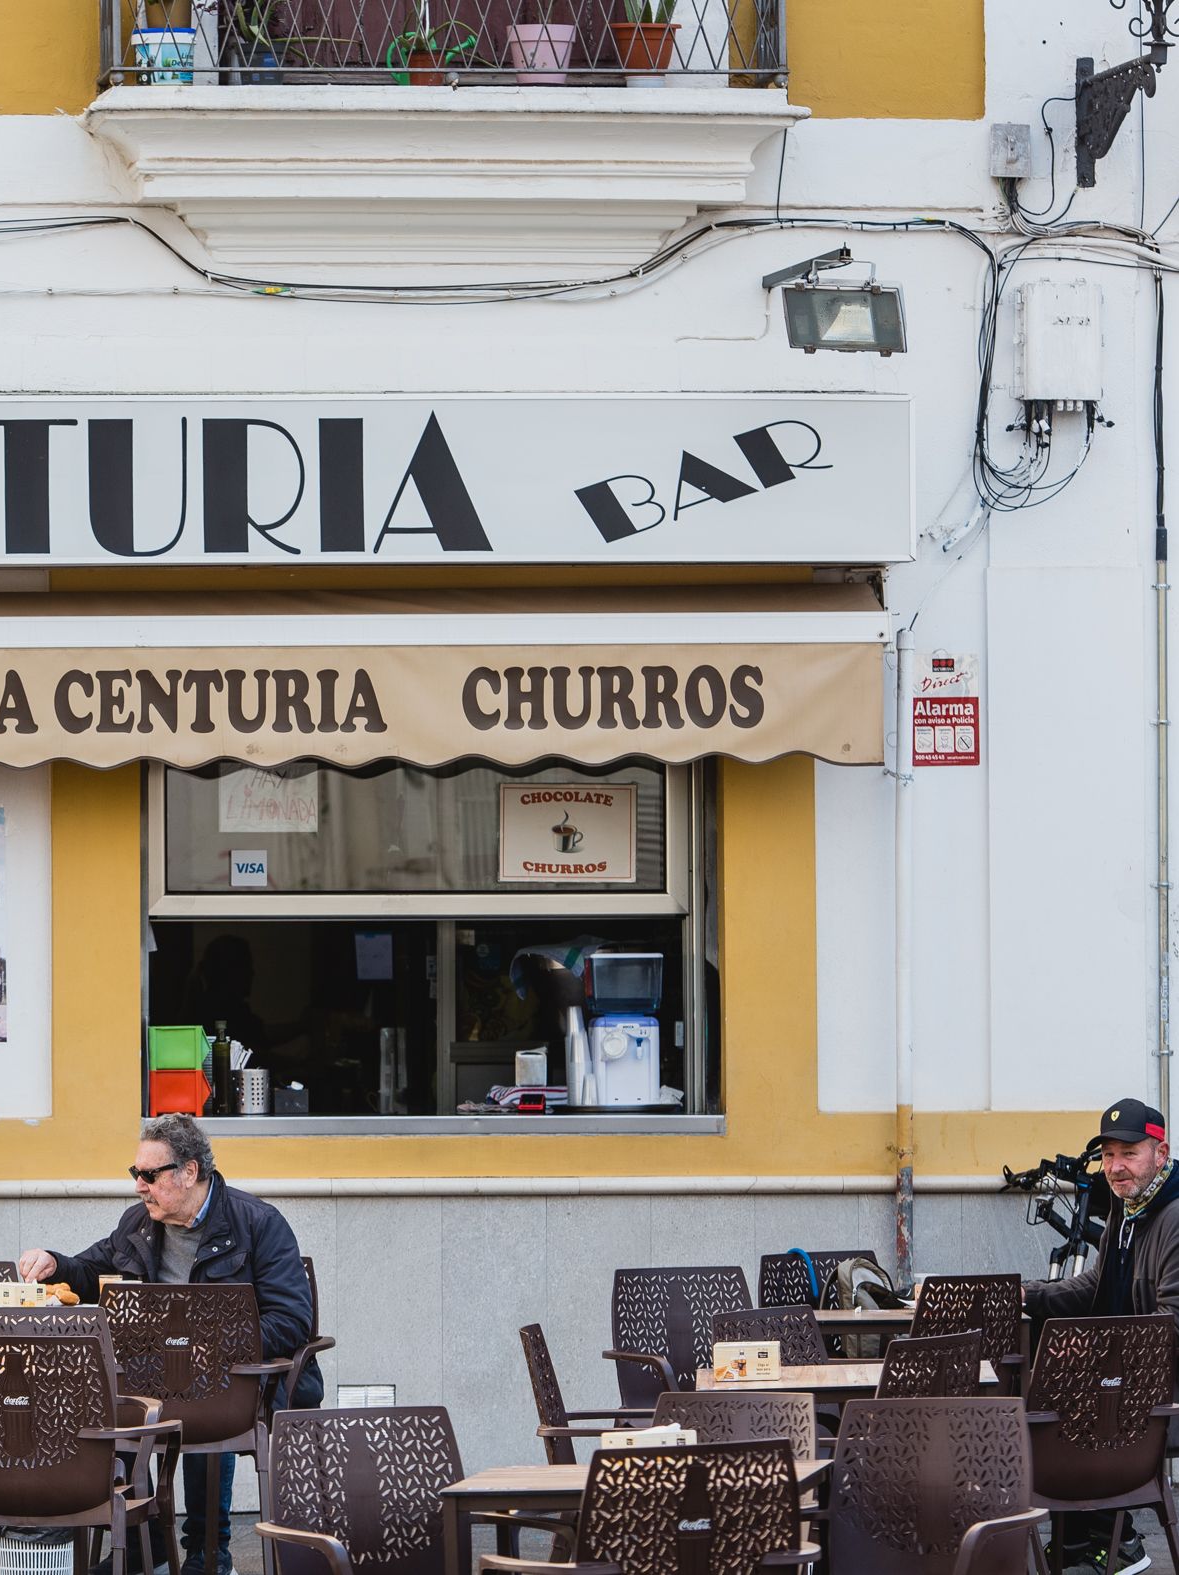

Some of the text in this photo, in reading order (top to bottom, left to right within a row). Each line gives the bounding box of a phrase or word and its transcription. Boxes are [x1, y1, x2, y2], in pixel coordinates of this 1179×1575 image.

[574, 420, 834, 544] BAR
[921, 671, 965, 692] Direct
[54, 669, 388, 735] CENTURIA
[462, 665, 765, 731] CHURROS
[914, 700, 974, 716] Alarma
[251, 770, 287, 789] HAY
[520, 791, 614, 807] CHOCOLATE
[234, 863, 265, 874] VISA
[522, 861, 607, 874] CHURROS
[165, 1336, 189, 1346] Coca-Cola
[1100, 1377, 1122, 1387] Coca-Cola
[4, 1396, 30, 1406] Coca-Cola
[678, 1518, 711, 1531] Coca-Cola
